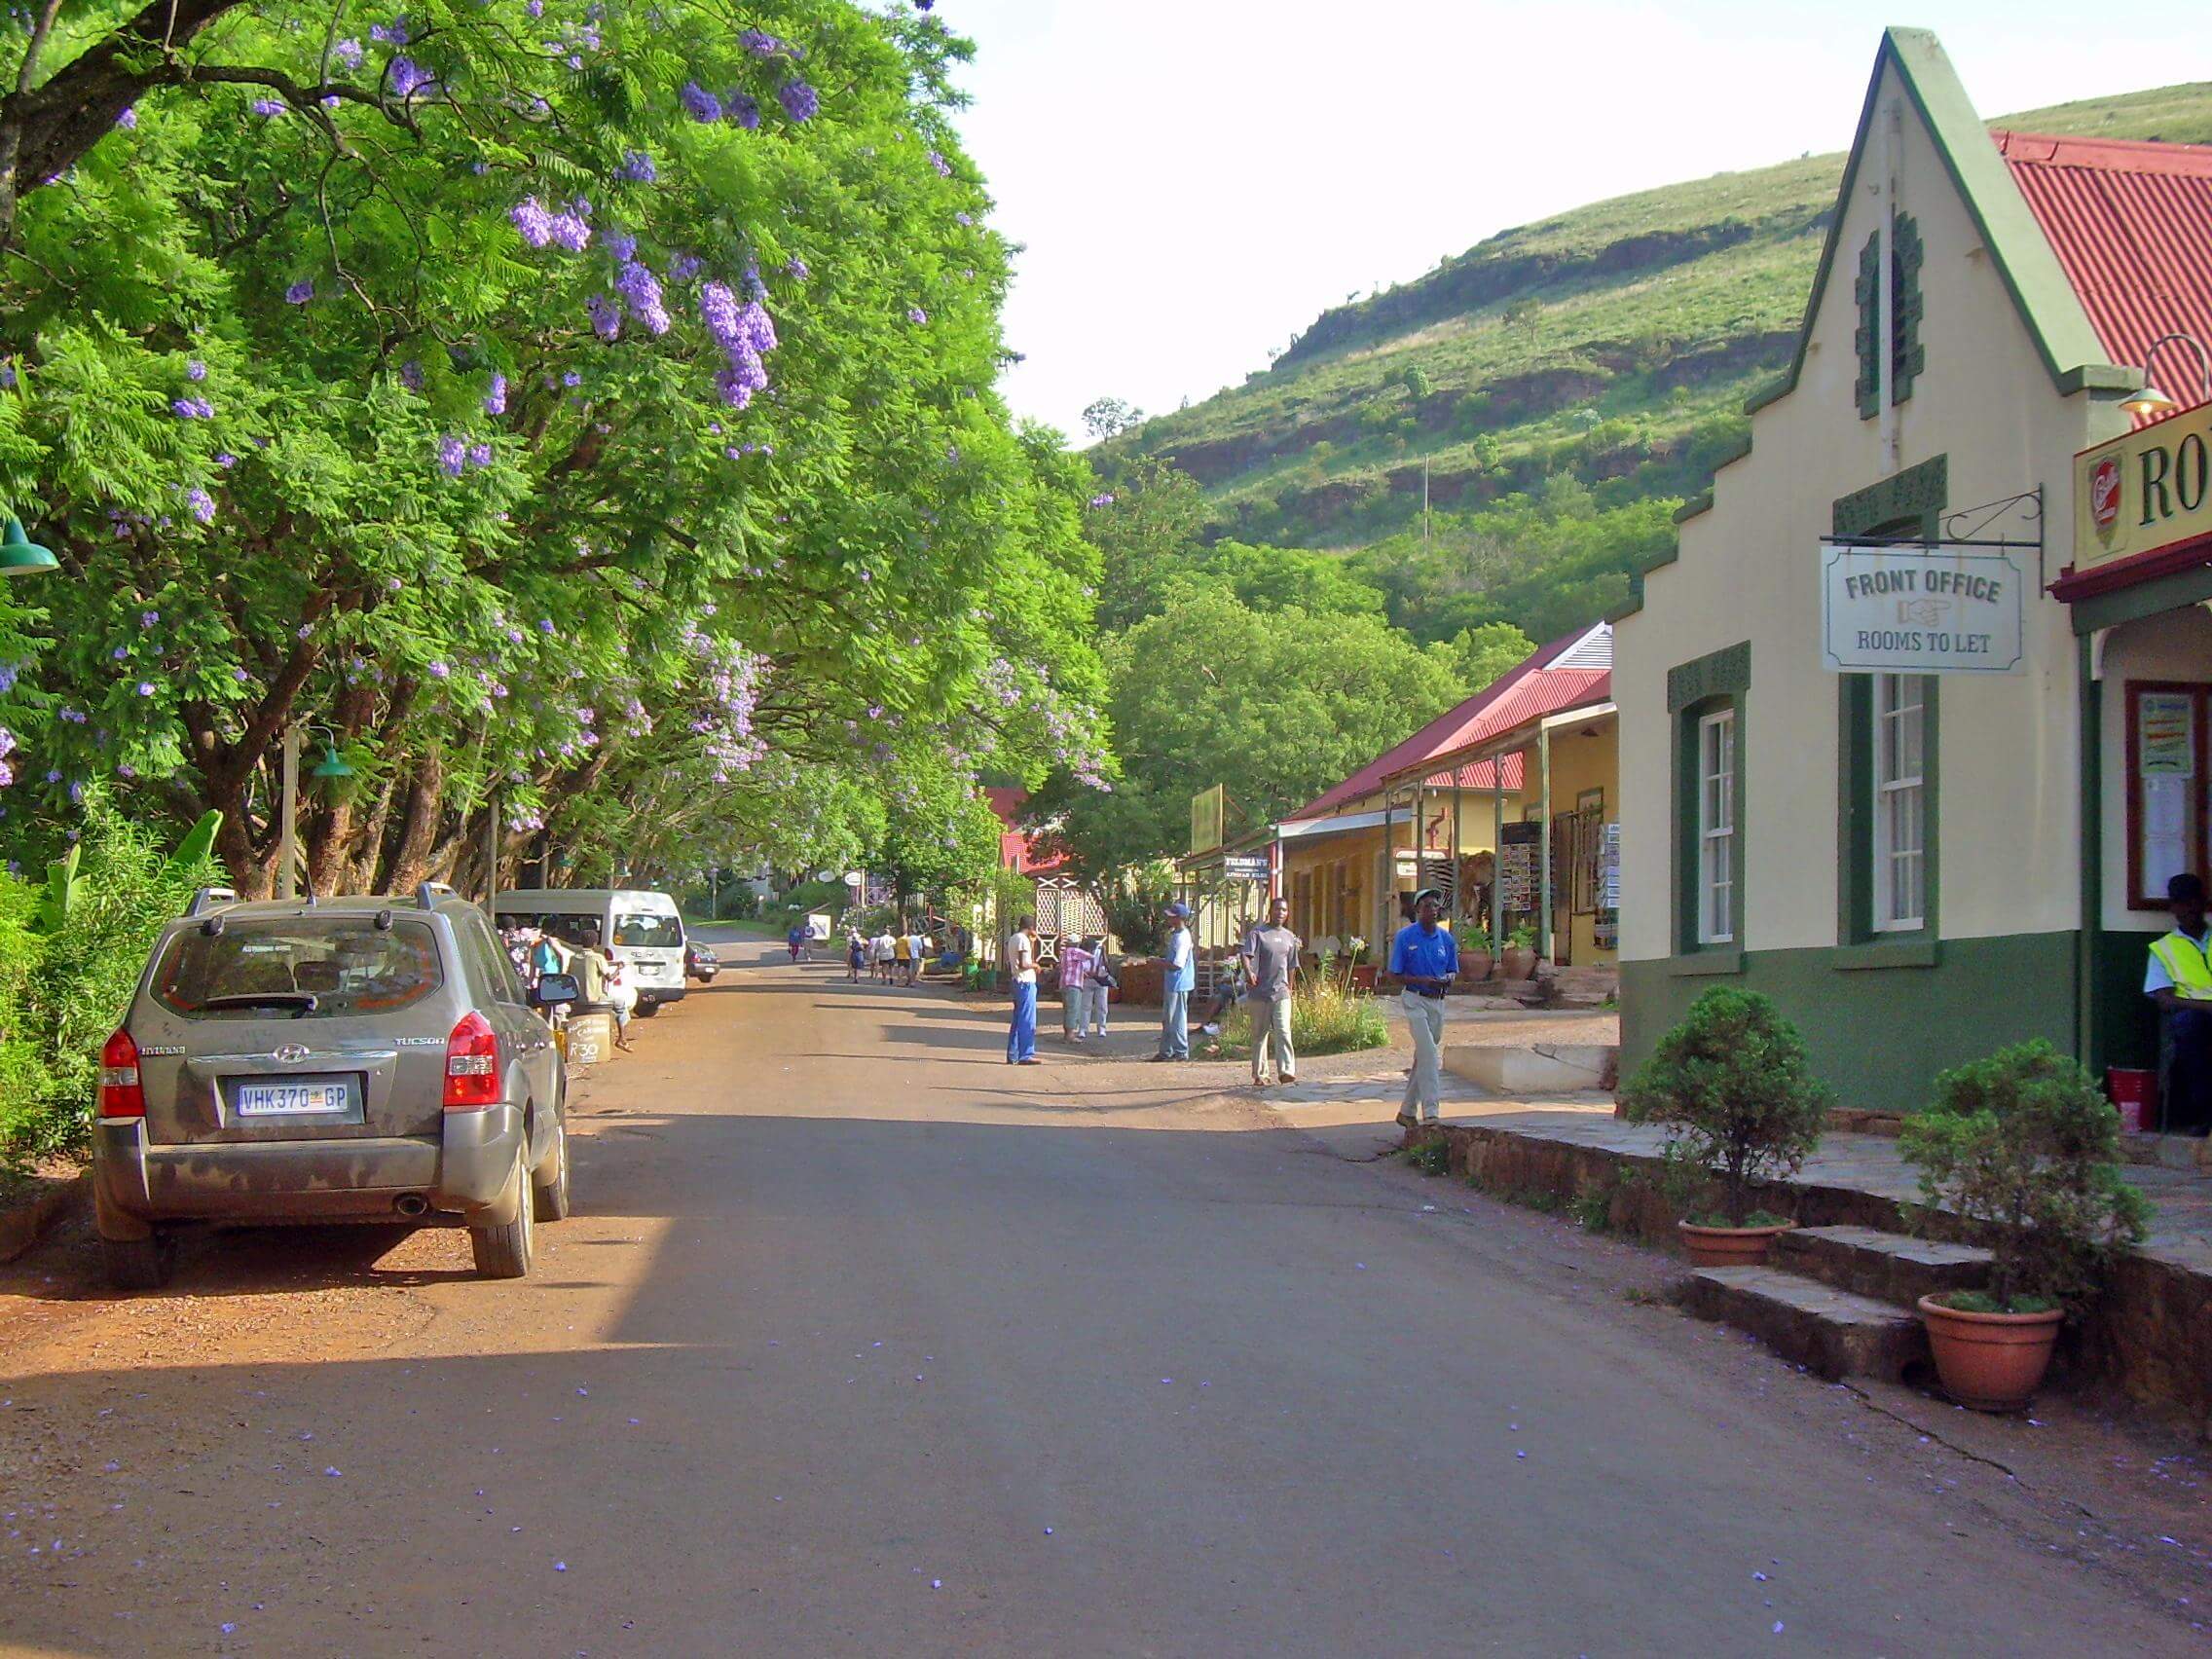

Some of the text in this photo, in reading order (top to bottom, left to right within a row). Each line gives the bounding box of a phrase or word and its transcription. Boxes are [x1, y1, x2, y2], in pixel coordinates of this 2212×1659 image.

[2138, 426, 2212, 527] RO
[1845, 569, 2002, 603] FRONT OFFICE
[1857, 630, 1992, 653] ROOMS TO LET
[394, 1037, 445, 1046] TUCSON
[324, 1087, 346, 1107] GP
